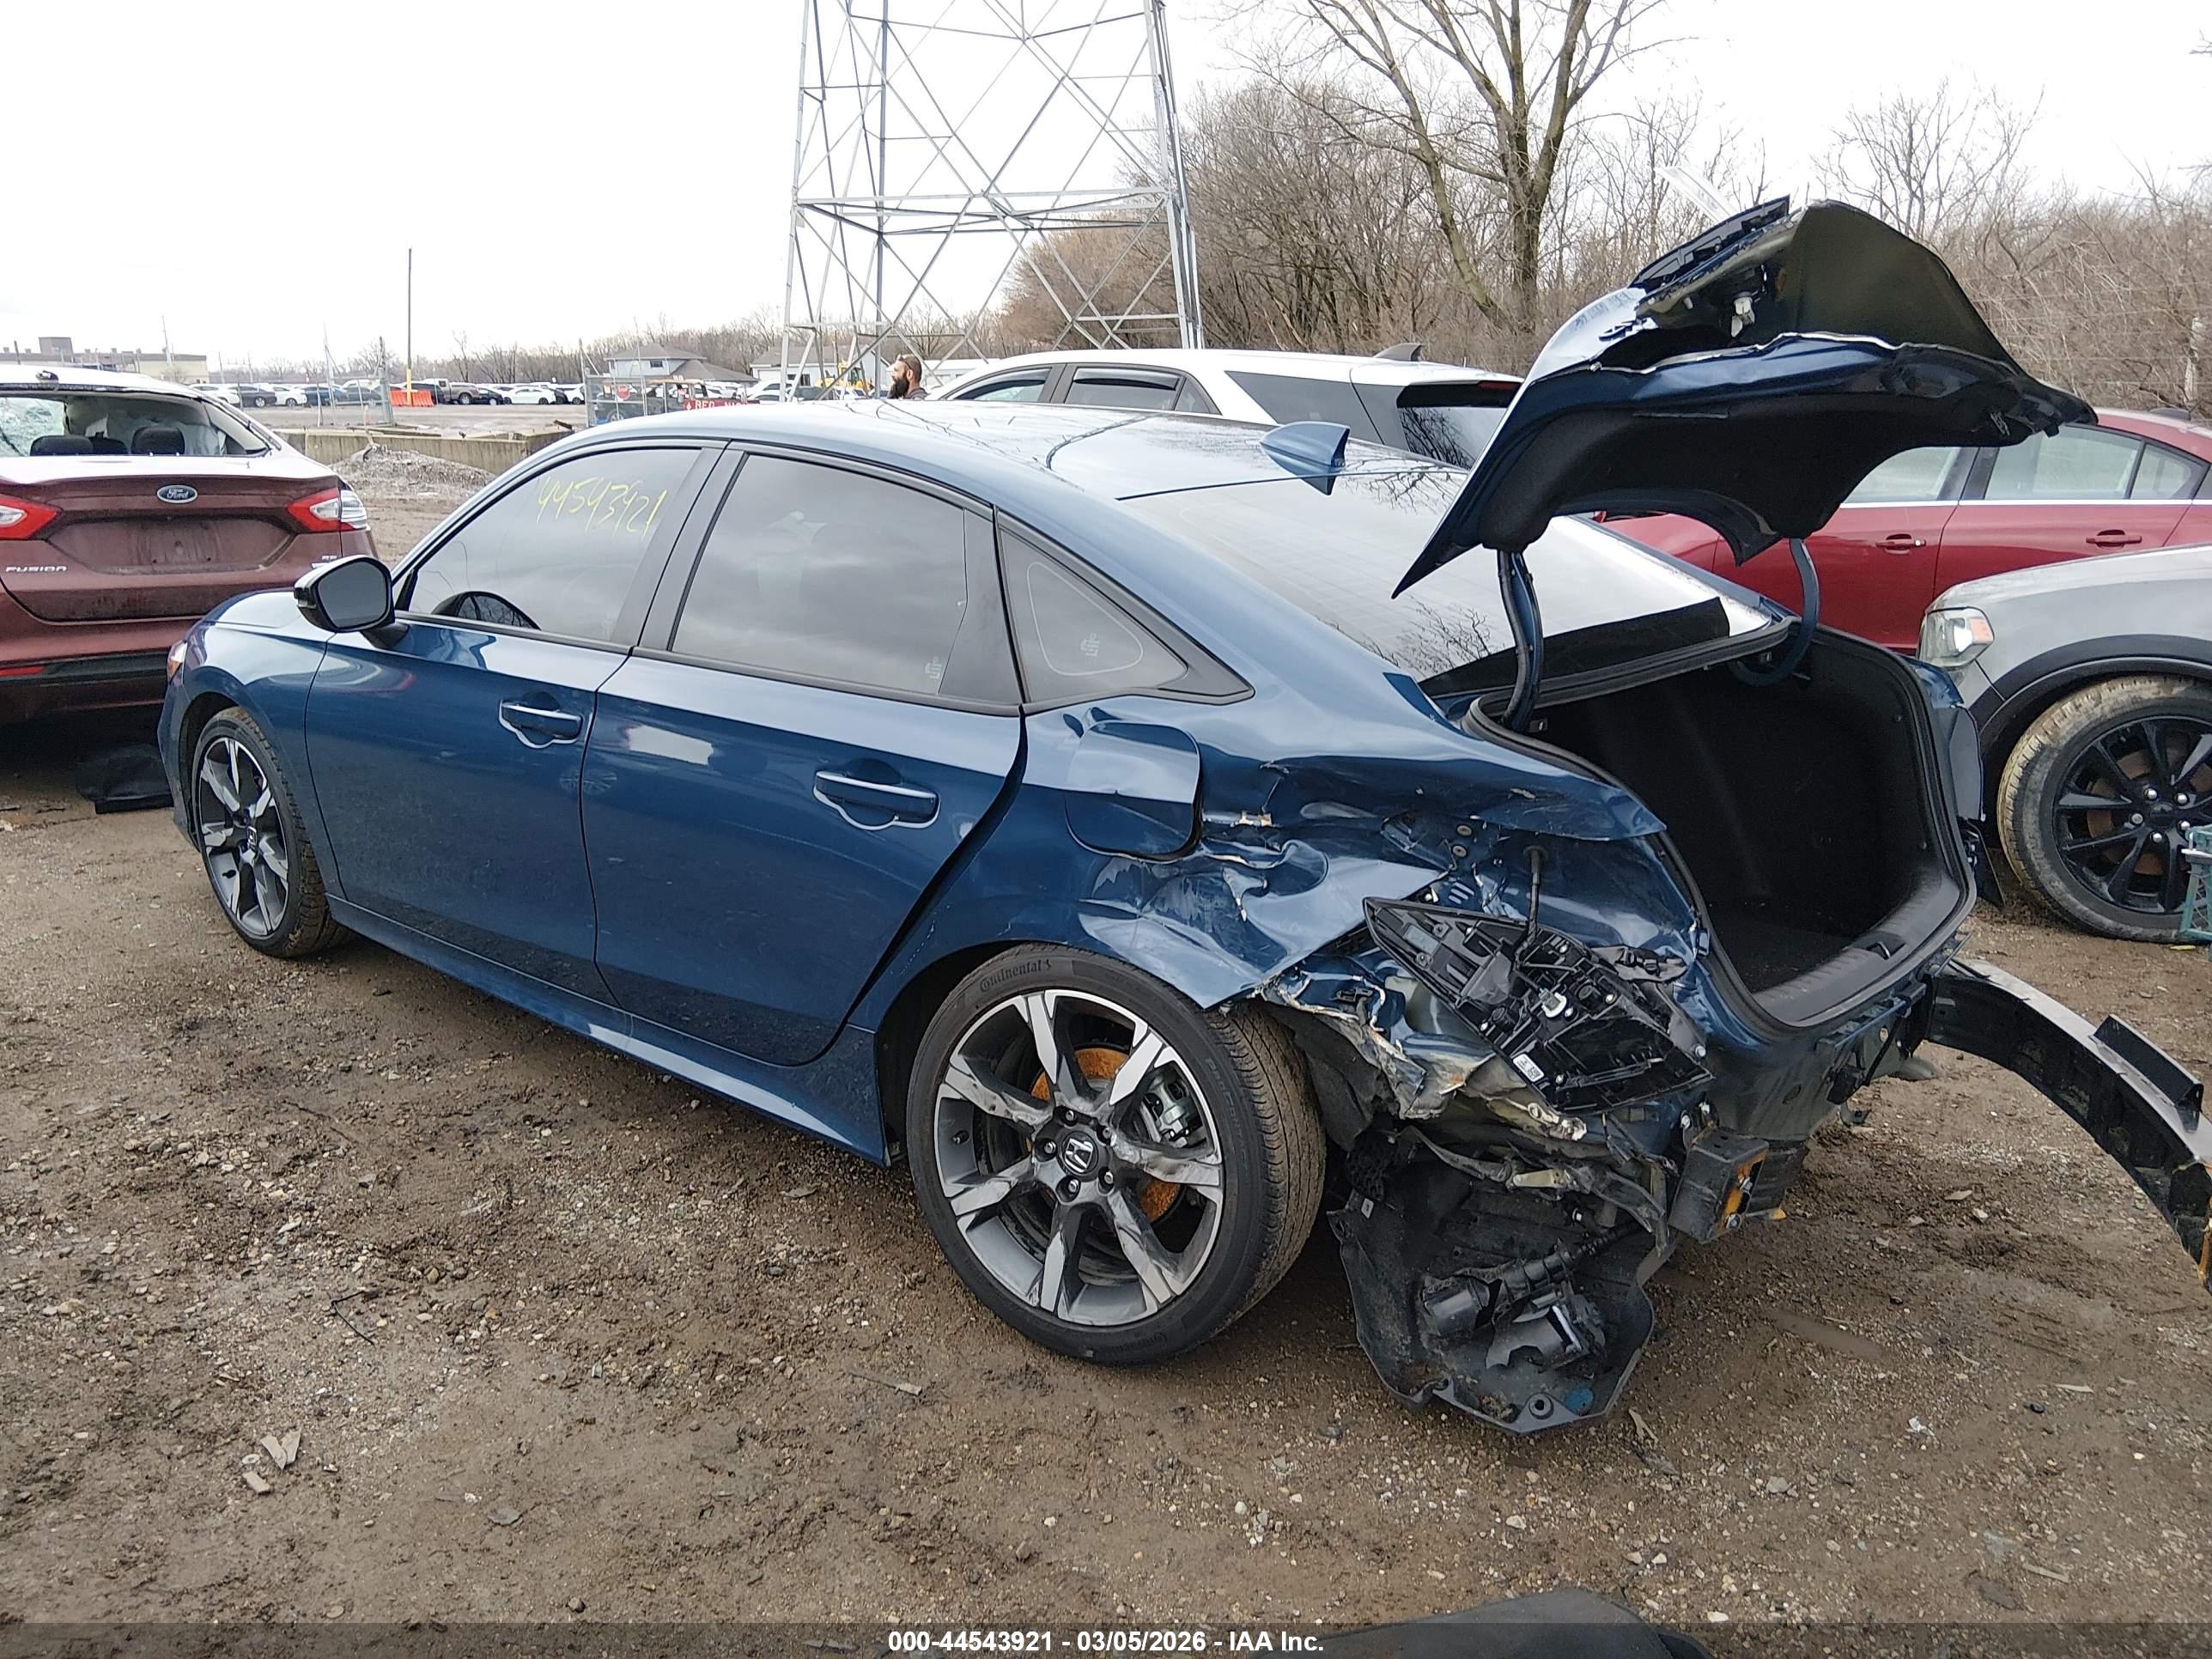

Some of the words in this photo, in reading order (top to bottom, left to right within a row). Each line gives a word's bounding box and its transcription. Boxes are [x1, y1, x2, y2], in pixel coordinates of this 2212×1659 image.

[166, 488, 190, 499] Ford
[536, 476, 667, 540] 44543921
[980, 959, 1042, 993] Continental
